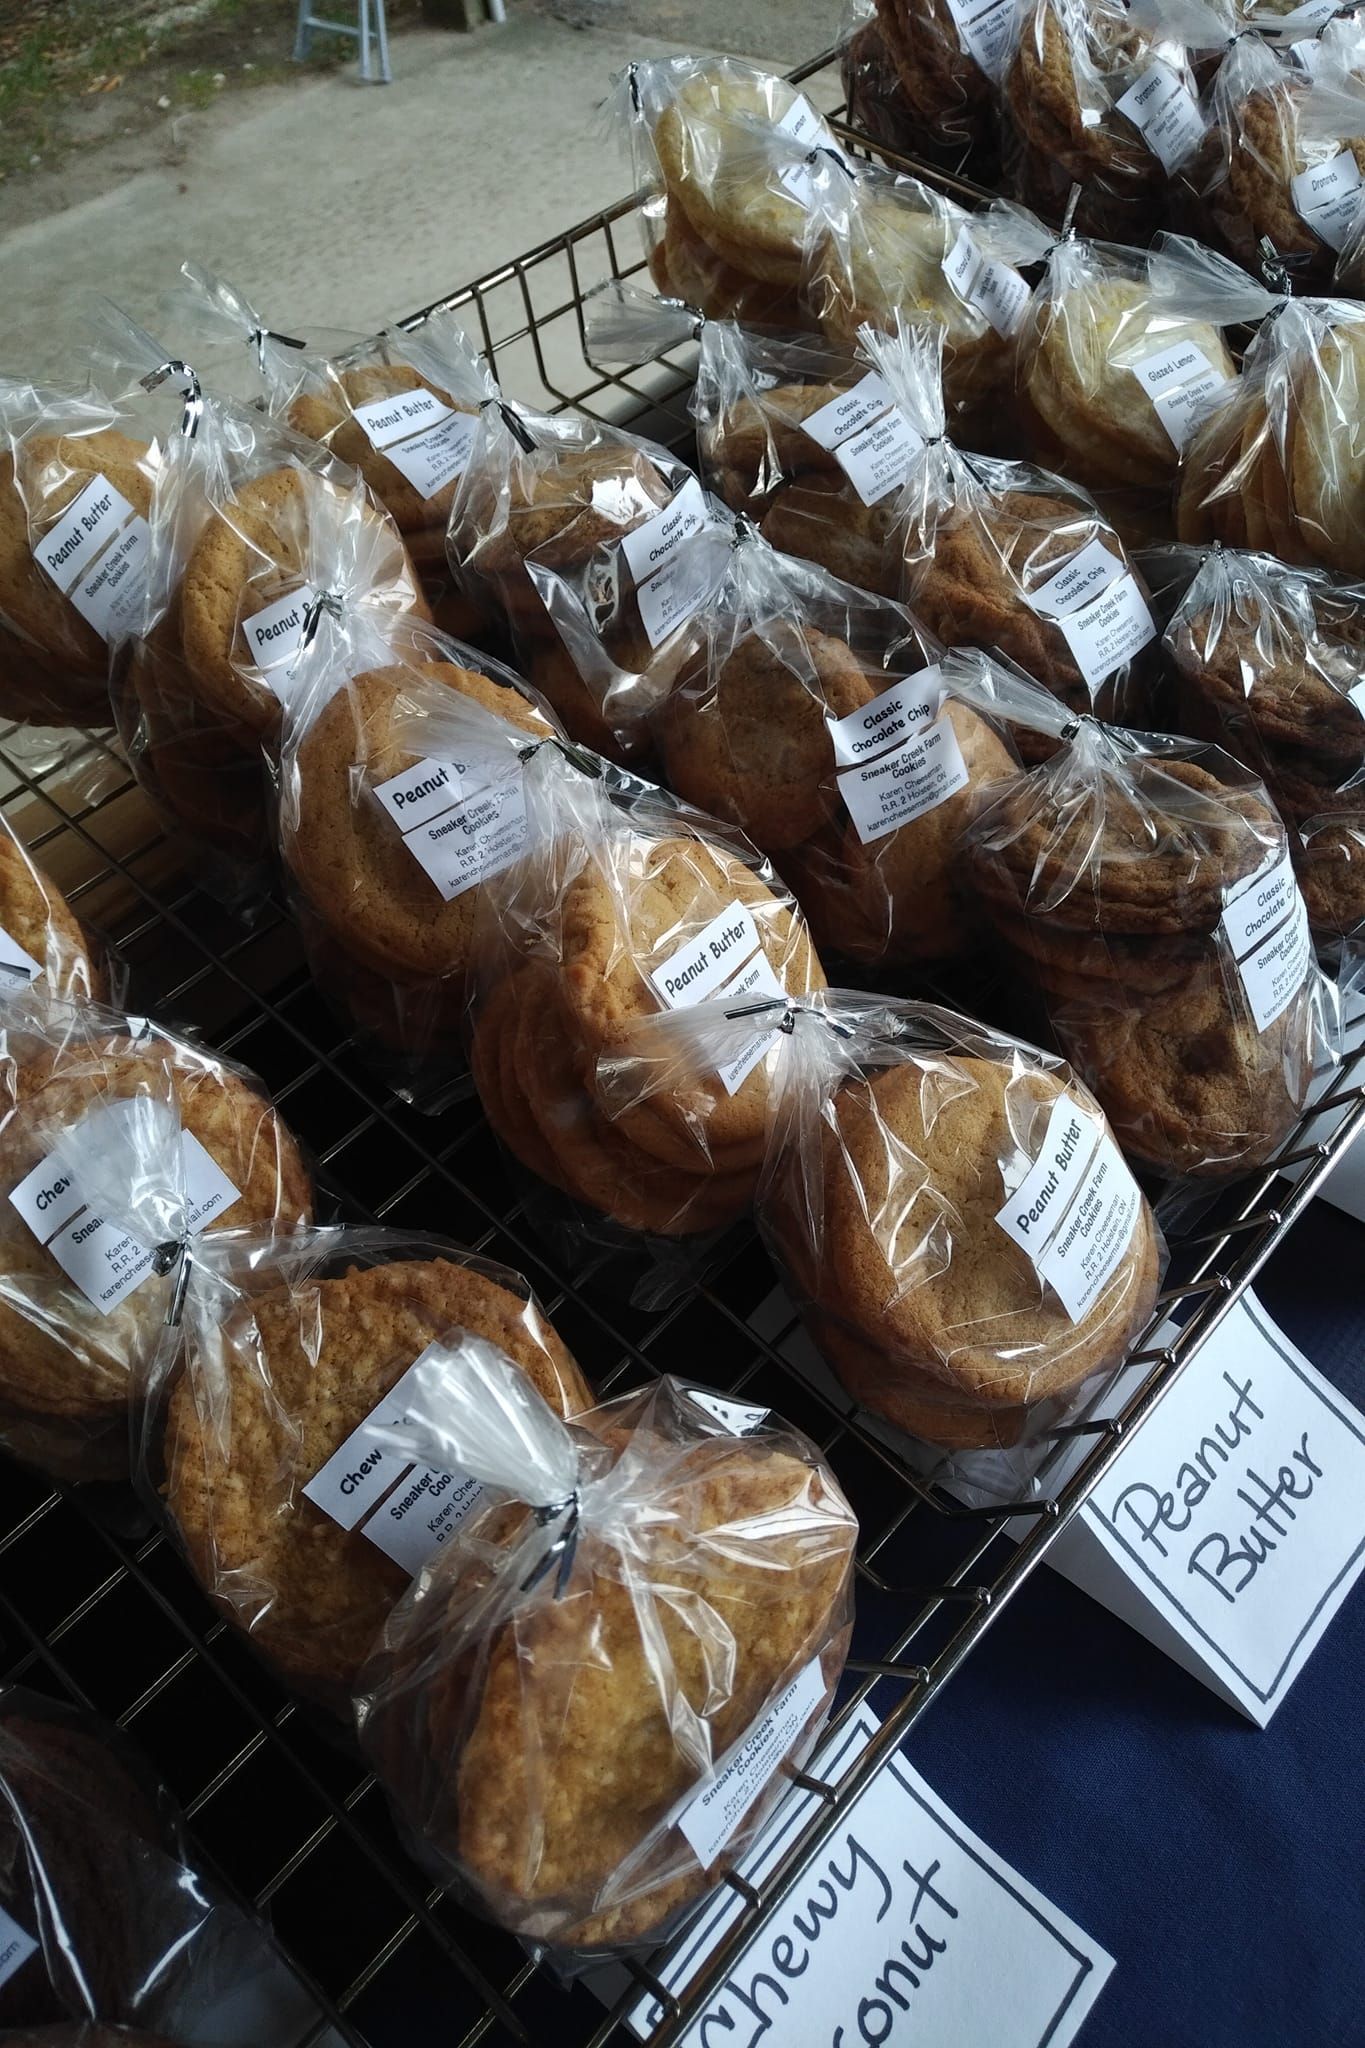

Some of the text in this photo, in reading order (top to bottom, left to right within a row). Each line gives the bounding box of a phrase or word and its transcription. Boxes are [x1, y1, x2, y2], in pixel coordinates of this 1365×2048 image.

[1148, 354, 1197, 382] Glazed Lemon
[367, 400, 436, 431] Peanut Butter
[834, 400, 885, 436] Chocolate Chip
[836, 399, 862, 416] Classic
[850, 436, 877, 457] Sneaker
[872, 434, 895, 453] Cookies
[47, 494, 112, 571] Peanut Butter
[661, 511, 684, 536] Classic
[649, 528, 684, 562] Chocolate
[84, 570, 111, 598] Sneaker
[104, 550, 126, 572] Creek
[120, 534, 139, 556] Farm
[107, 560, 131, 588] Cookies
[1054, 568, 1082, 591] Classic
[1055, 566, 1107, 606] Chocolate Chip
[255, 609, 301, 646] Peanut
[1077, 590, 1128, 631] Sneaker Creek Farm
[1098, 610, 1120, 628] Cookies
[851, 702, 931, 754] Chocolate Chip
[863, 701, 904, 730] Classic
[860, 732, 942, 782] Sneaker Creek Farm
[892, 756, 928, 780] Cookies
[392, 766, 450, 810] Peanut
[878, 763, 944, 802] Karen Cheeseman
[881, 800, 900, 814] R.R.
[900, 796, 908, 806] 2
[936, 772, 948, 784] ON
[428, 814, 468, 842] Sneaker
[467, 800, 496, 820] Creek
[866, 773, 962, 834] karencheeseman@gmail.com
[462, 810, 500, 836] Cookies
[455, 840, 480, 858] Karen
[459, 855, 479, 868] R.R.
[478, 850, 486, 860] 2
[1257, 876, 1286, 908] Classic
[1244, 898, 1286, 938] Chocolate
[664, 921, 746, 998] Peanut Butter
[1257, 938, 1285, 970] Sneaker
[1280, 934, 1300, 962] Cookies
[743, 968, 761, 992] Farm
[1271, 968, 1288, 988] Karen
[1016, 1118, 1083, 1236] Peanut Butter
[1057, 1161, 1109, 1259] Sneaker Creek Farm
[1080, 1198, 1104, 1240] Cookies
[104, 1236, 134, 1262] Karen
[1076, 1190, 1138, 1309] karencheeseman@gmail.com
[1080, 1193, 1122, 1271] Karen Cheeseman
[1084, 1261, 1100, 1282] R.R.
[1098, 1254, 1106, 1264] 2
[1118, 1200, 1128, 1215] ON
[111, 1246, 142, 1274] R.R. 2
[1112, 1370, 1264, 1558] Peanut
[390, 1468, 433, 1521] Sneaker
[427, 1504, 456, 1533] Karen
[1188, 1432, 1324, 1604] Butter
[702, 1682, 799, 1807] Sneaker Creek Farm
[737, 1728, 776, 1778] Cookies
[723, 1778, 750, 1812] Karen
